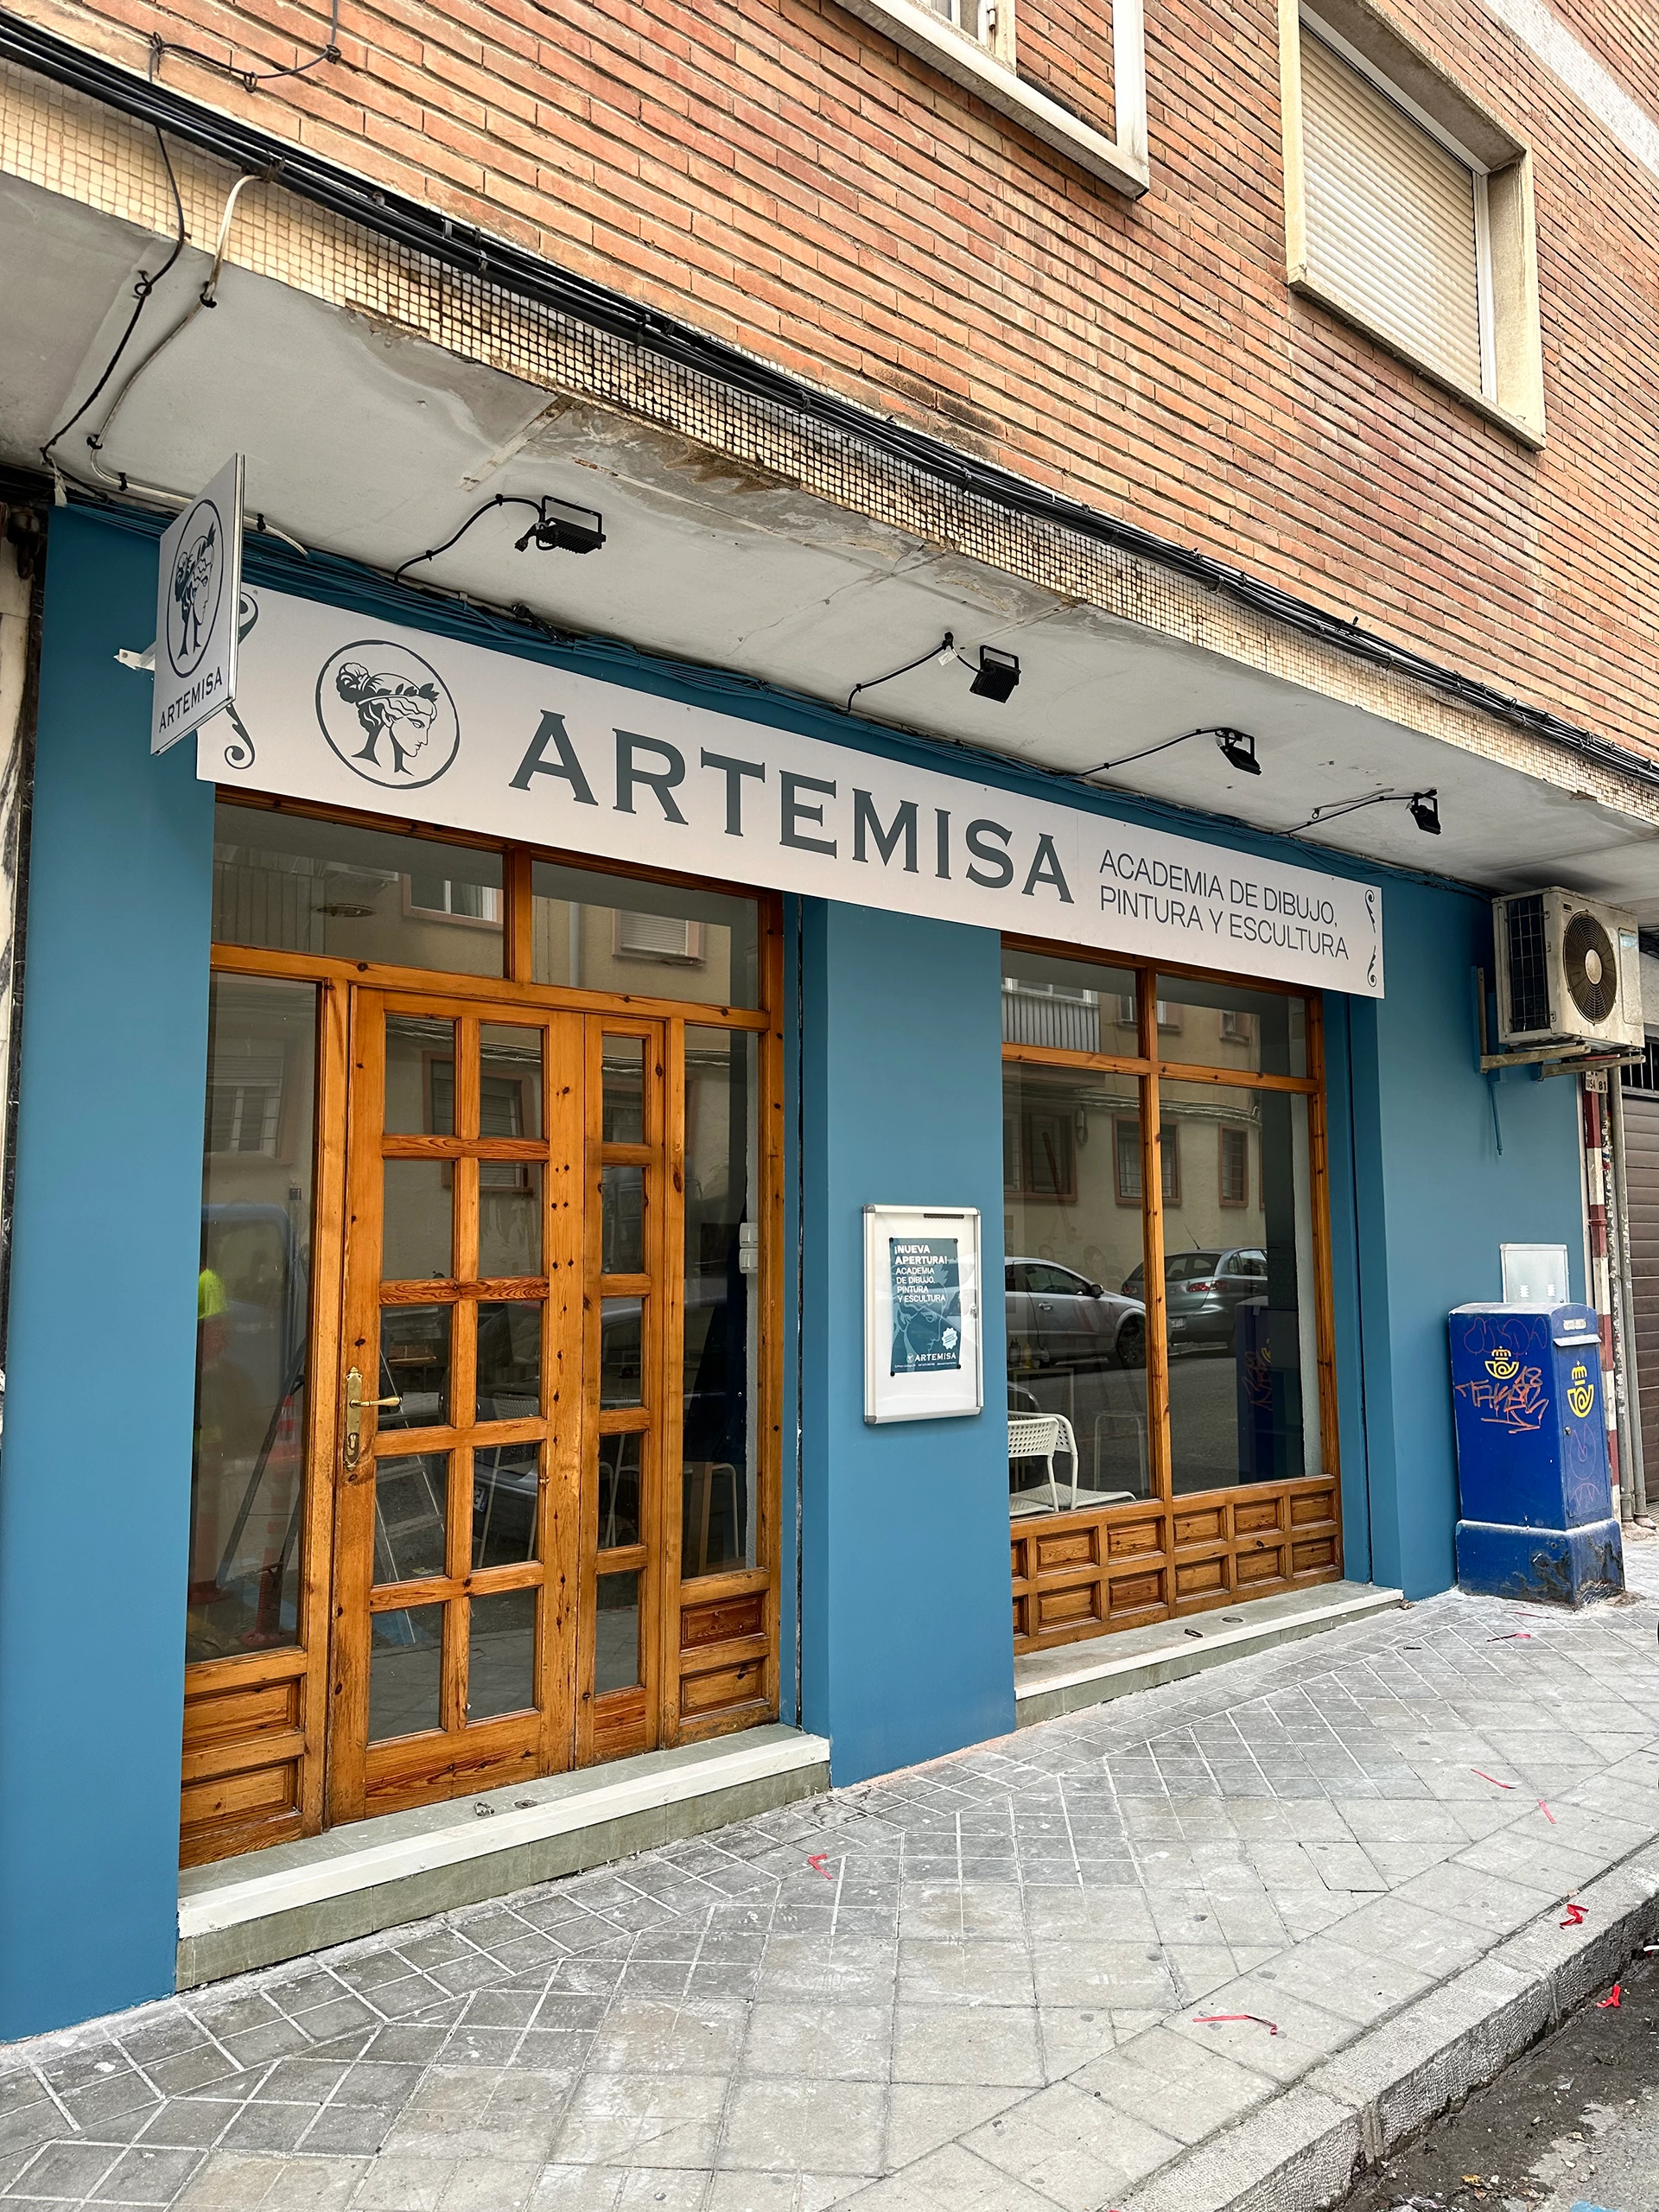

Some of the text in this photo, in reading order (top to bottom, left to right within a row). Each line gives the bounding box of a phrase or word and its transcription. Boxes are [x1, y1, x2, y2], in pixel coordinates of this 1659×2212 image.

[159, 666, 223, 733] ARTEMISA
[508, 709, 1075, 905] ARTEMISA
[1099, 849, 1338, 928] ACADEMIA DE DIBUJO,
[1100, 885, 1349, 960] PINTURA Y ESCULTURA
[1599, 1080, 1606, 1090] 81
[894, 1245, 931, 1255] ¡NUEVA
[895, 1255, 948, 1265] APERTURA!
[895, 1267, 935, 1275] ACADEMIA
[904, 1294, 946, 1303] ESCULTURA
[914, 1351, 957, 1362] ARTEMISA
